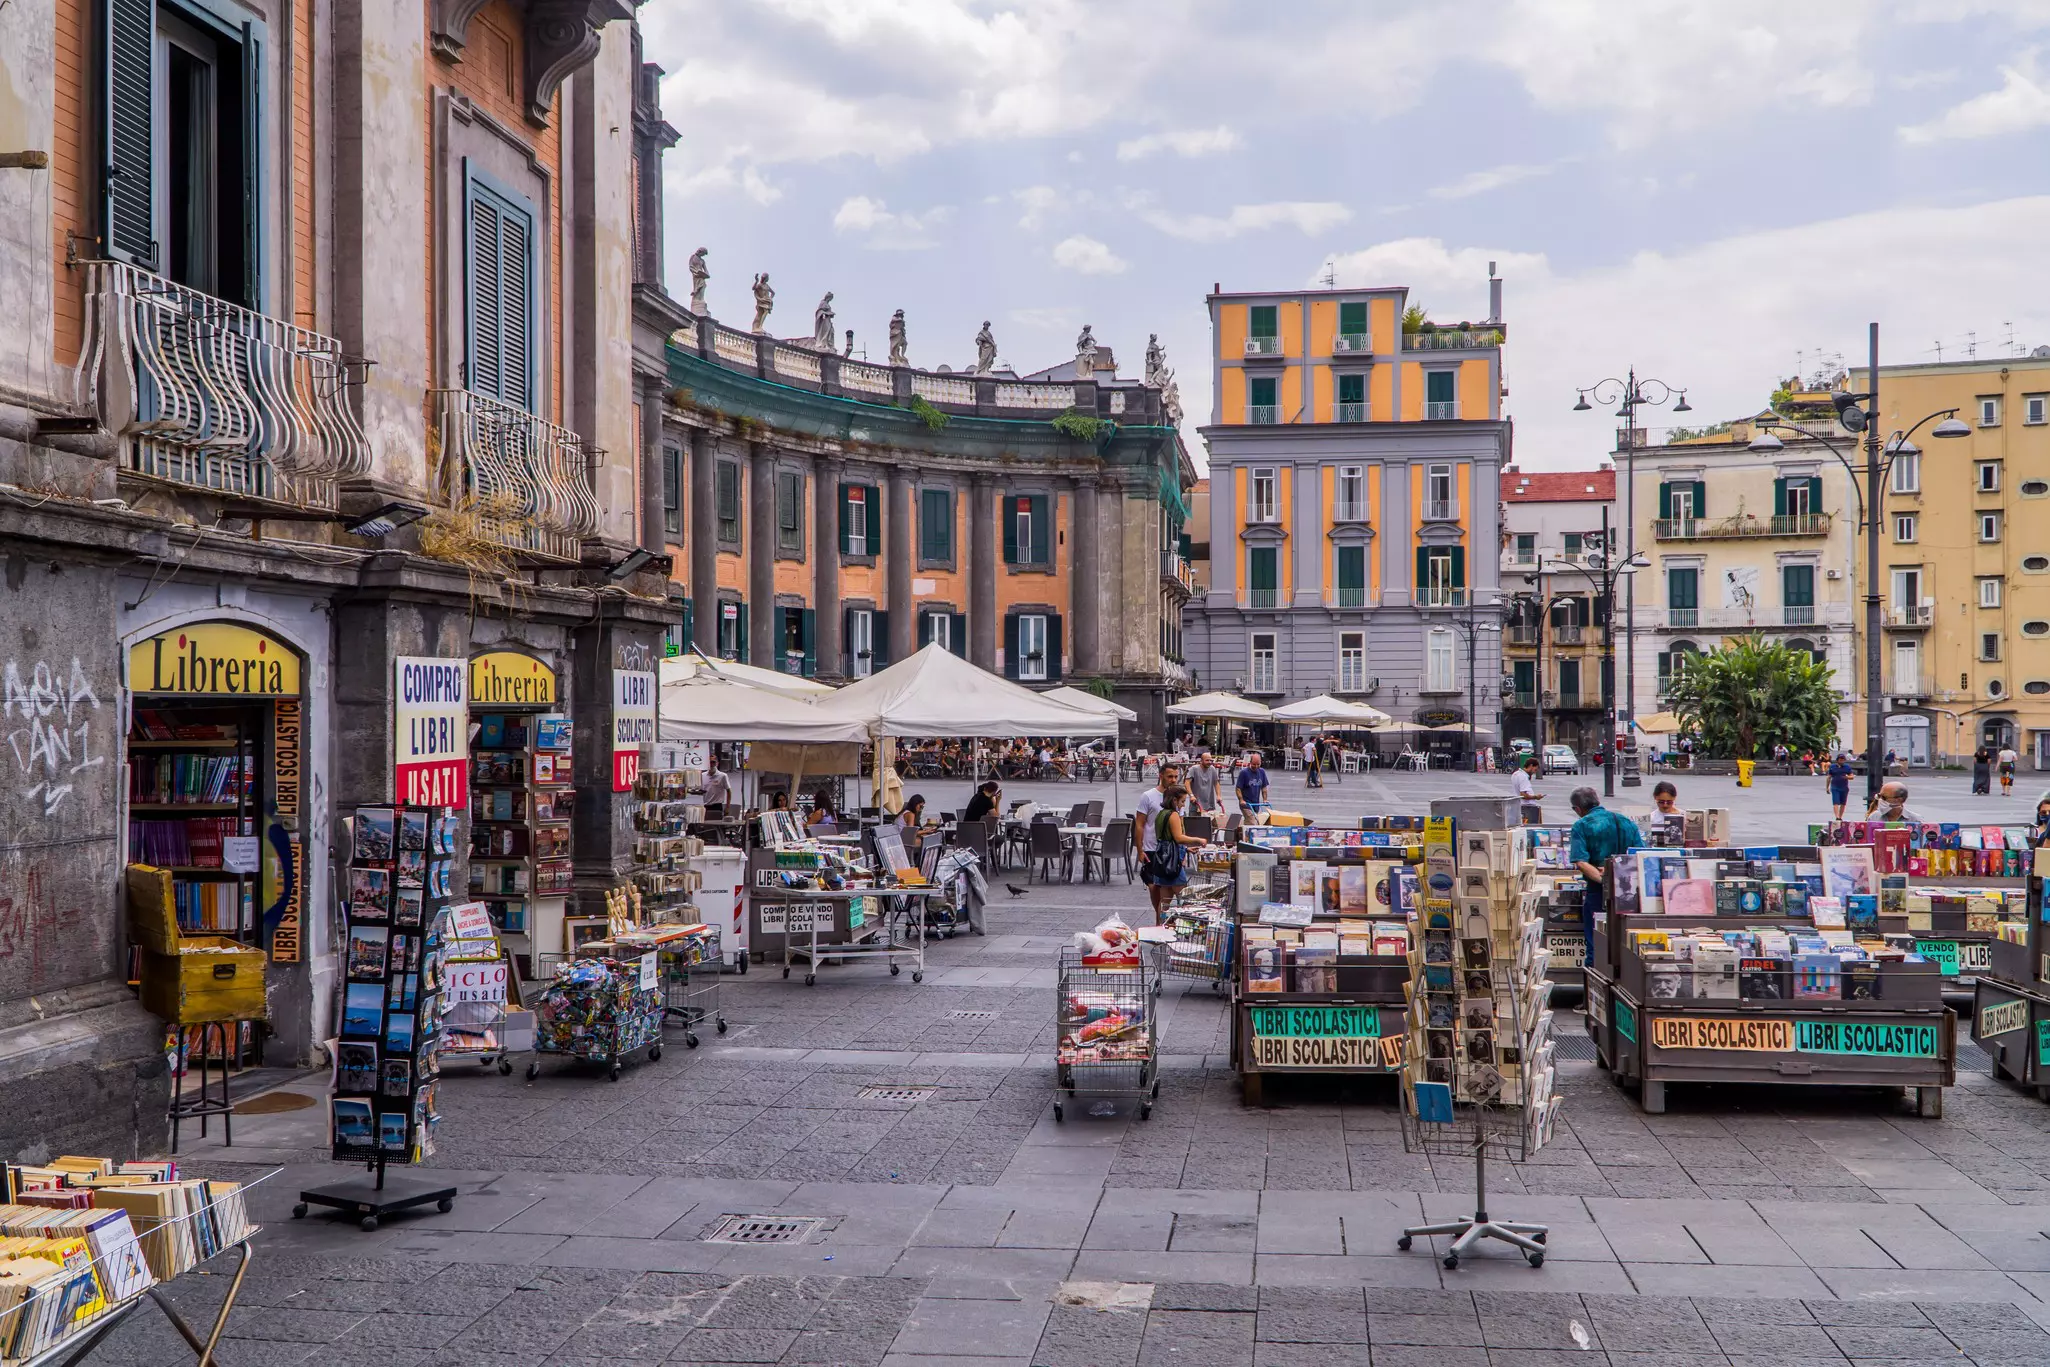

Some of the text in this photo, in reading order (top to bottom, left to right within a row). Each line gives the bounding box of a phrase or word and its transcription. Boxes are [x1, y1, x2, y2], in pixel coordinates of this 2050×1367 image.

[150, 633, 283, 693] Libreria
[403, 663, 461, 703] COMPRO
[469, 658, 549, 702] Libreria
[622, 675, 649, 705] LIBRI
[411, 716, 455, 756] LIBRI
[617, 717, 653, 743] SCOLASTICI
[276, 699, 299, 815] LIBRI SCOLASTICI
[407, 766, 458, 806] USATI
[763, 906, 797, 914] COMPO
[806, 905, 833, 913] VNDO
[763, 914, 833, 923] LIBRI SCOLATICI
[785, 924, 813, 932] SATI
[275, 926, 297, 962] LIBRI
[1921, 944, 1955, 952] VENDO
[1742, 960, 1776, 970] FIDEL
[460, 985, 506, 1002] usati
[1252, 1009, 1378, 1035] LIBRI SCOLASTICI
[1654, 1021, 1788, 1049] LIBRI SCOLASTICI
[1982, 1007, 1995, 1037] LIBRI
[1292, 1038, 1377, 1065] SCOLASTICI
[1799, 1020, 1935, 1055] LIBRI SCOLASTICI
